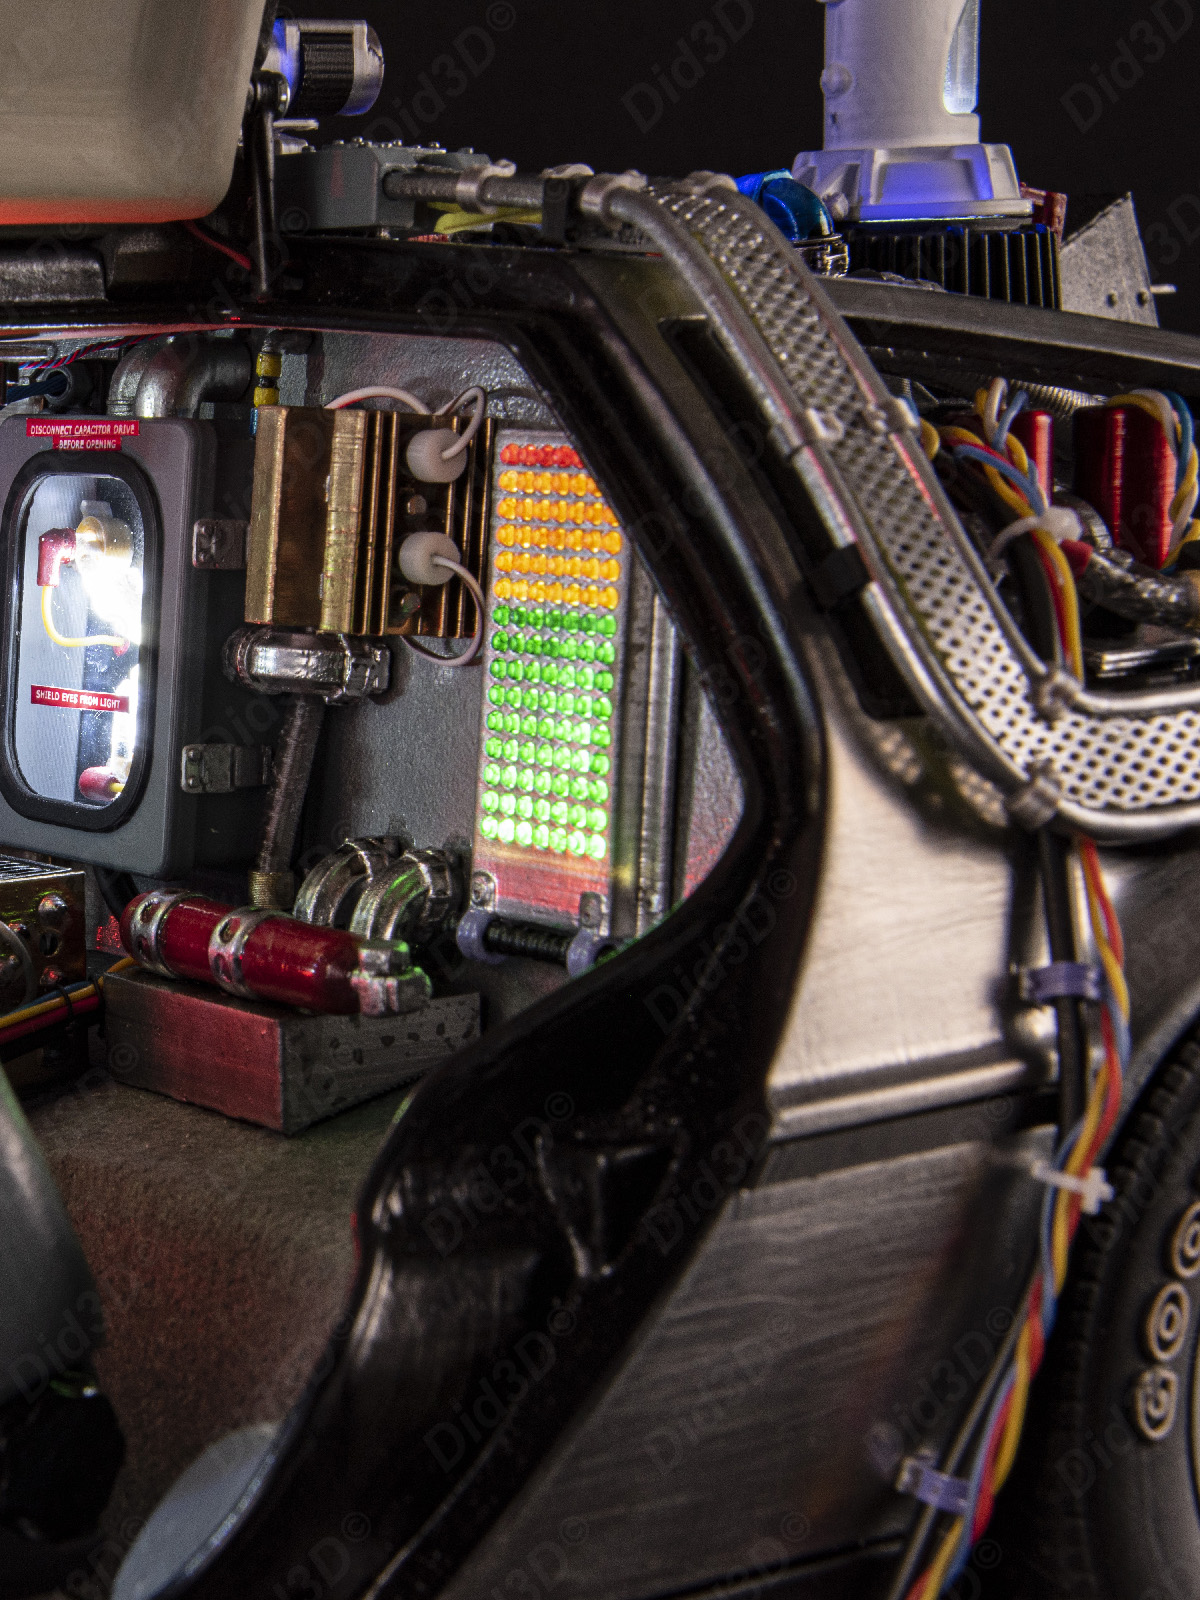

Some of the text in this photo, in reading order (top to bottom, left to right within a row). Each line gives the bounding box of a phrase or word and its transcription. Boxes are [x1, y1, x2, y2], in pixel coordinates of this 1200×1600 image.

[31, 424, 135, 435] DISCONNECT CAPACITOR DRIVE
[58, 439, 117, 449] BEFORE OPENING
[36, 690, 121, 709] SHIELD EYES FROM LIGHT
